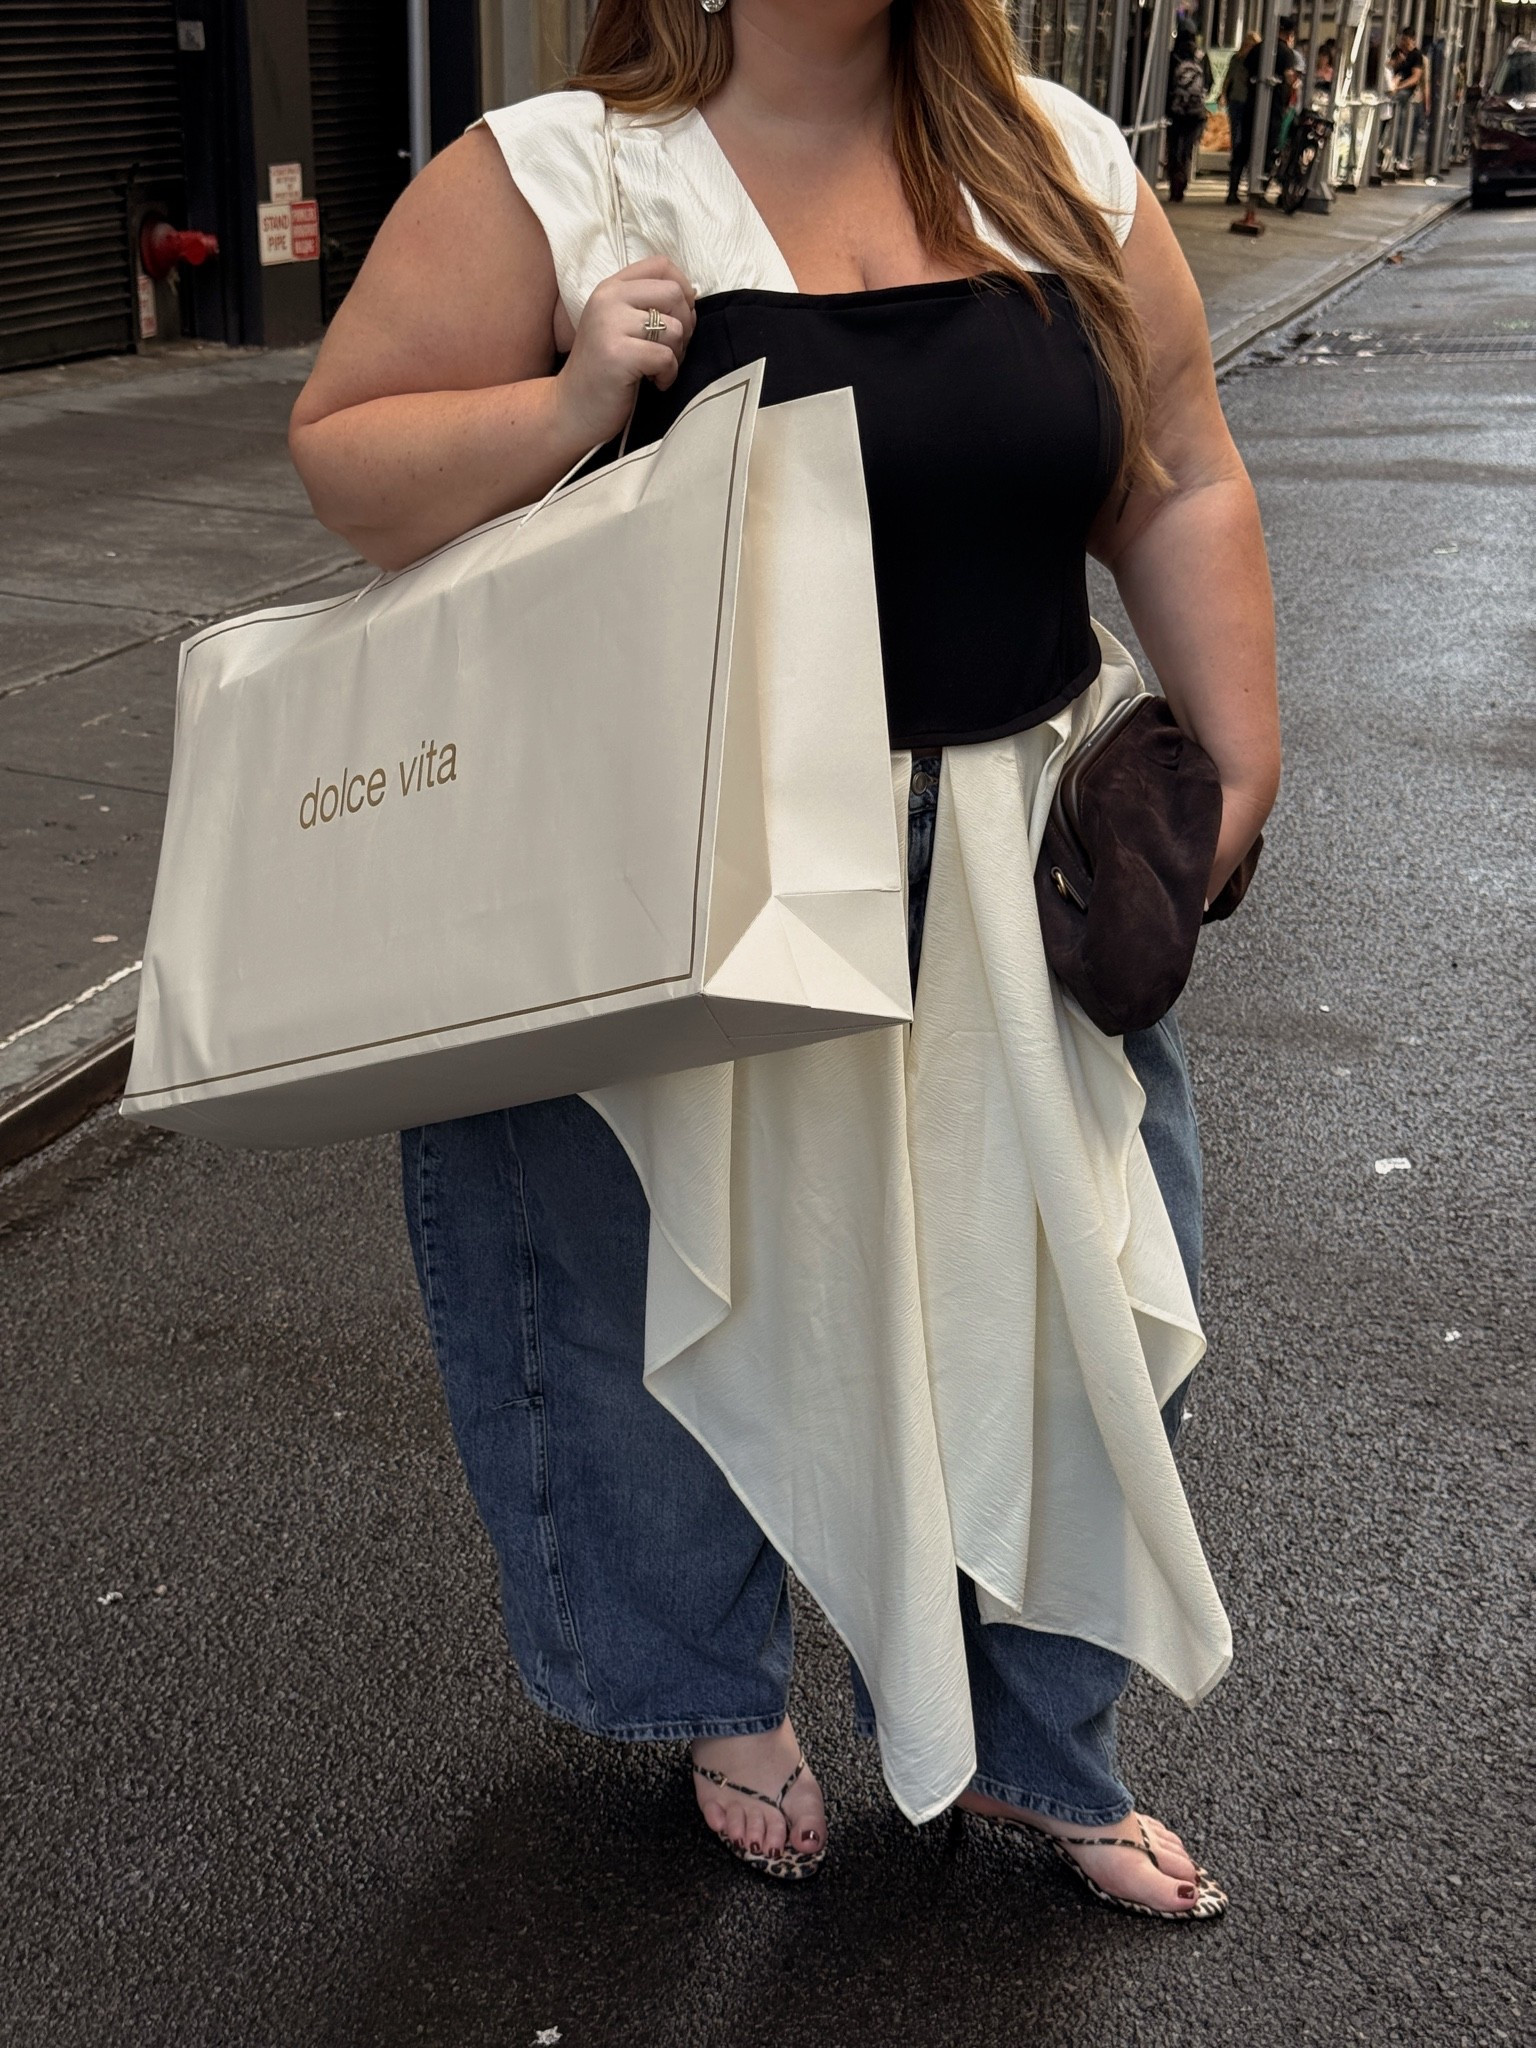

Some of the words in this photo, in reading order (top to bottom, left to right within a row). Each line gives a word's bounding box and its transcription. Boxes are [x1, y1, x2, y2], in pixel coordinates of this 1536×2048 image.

[263, 215, 290, 232] STAND
[267, 235, 287, 252] PIPE
[299, 767, 387, 830] dolce
[399, 739, 457, 797] vita
